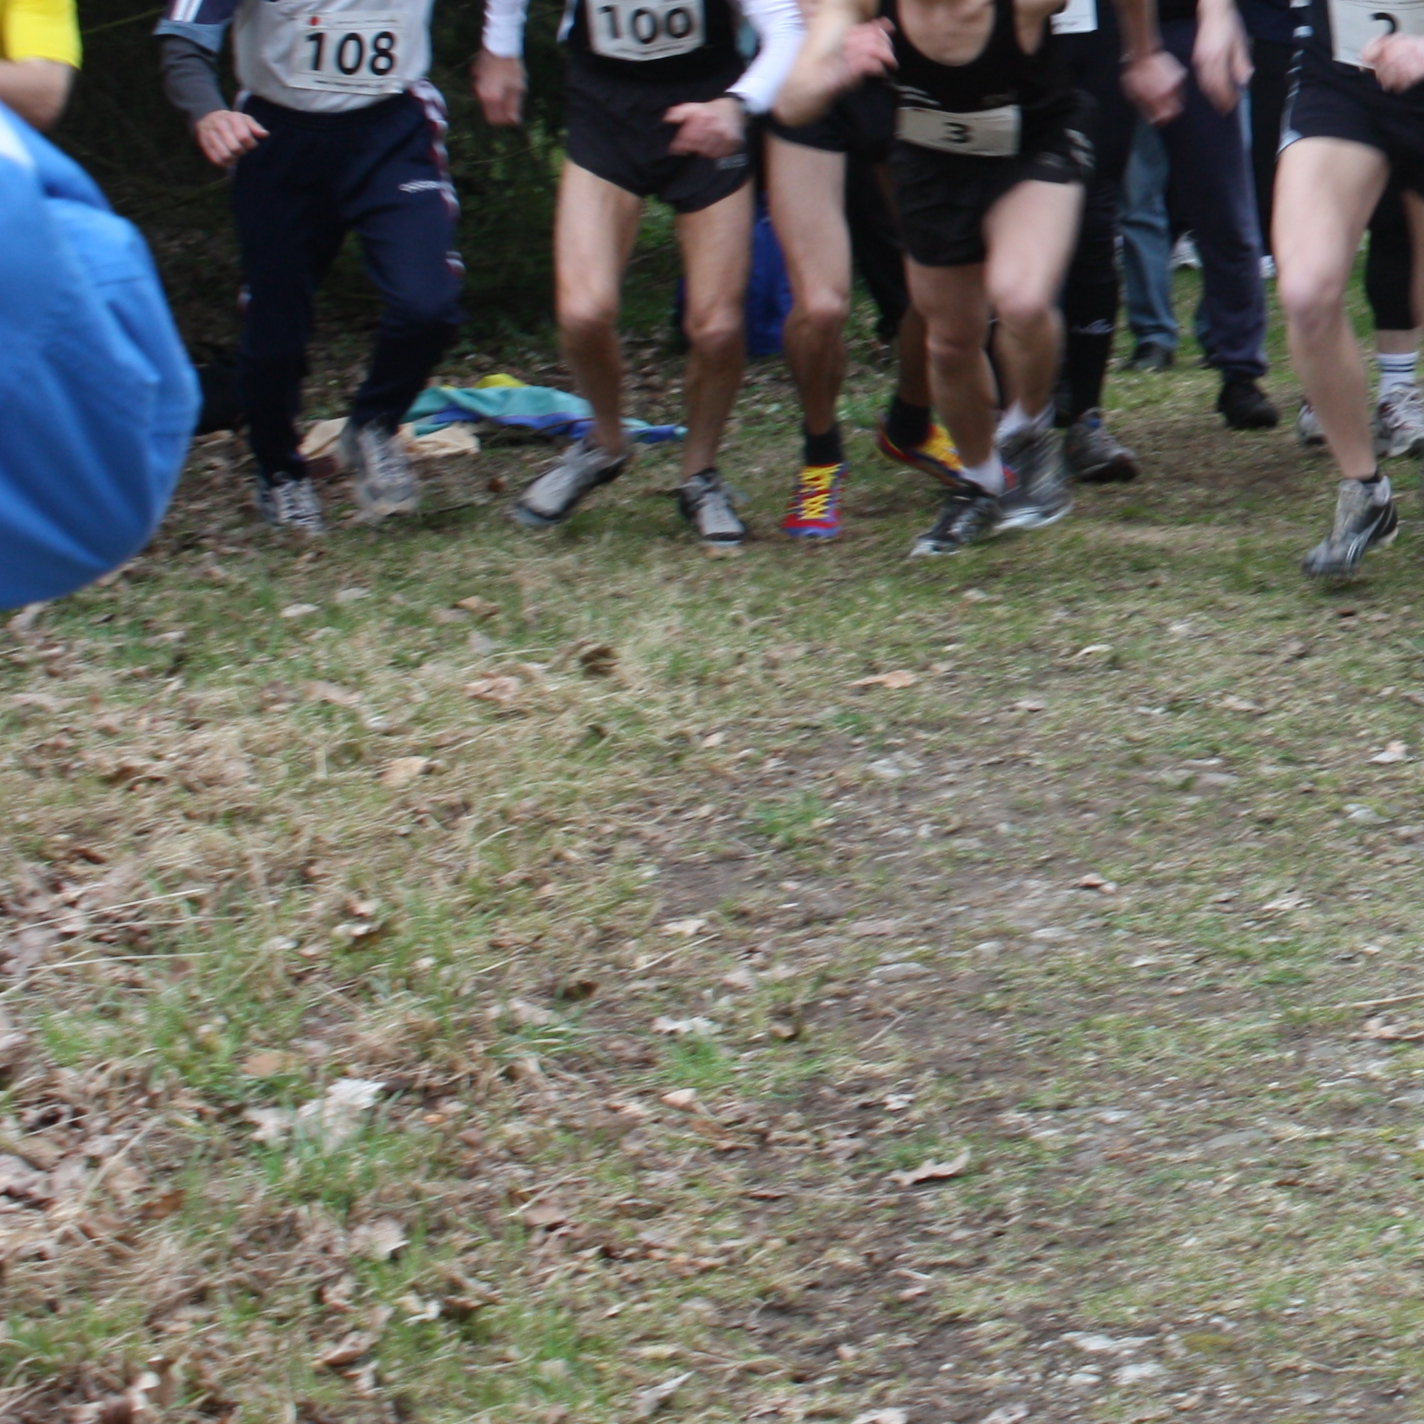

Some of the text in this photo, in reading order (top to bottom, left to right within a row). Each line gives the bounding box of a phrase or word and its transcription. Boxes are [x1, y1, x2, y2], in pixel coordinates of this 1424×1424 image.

[598, 4, 692, 45] 100
[304, 30, 397, 76] 108
[942, 121, 973, 144] 3
